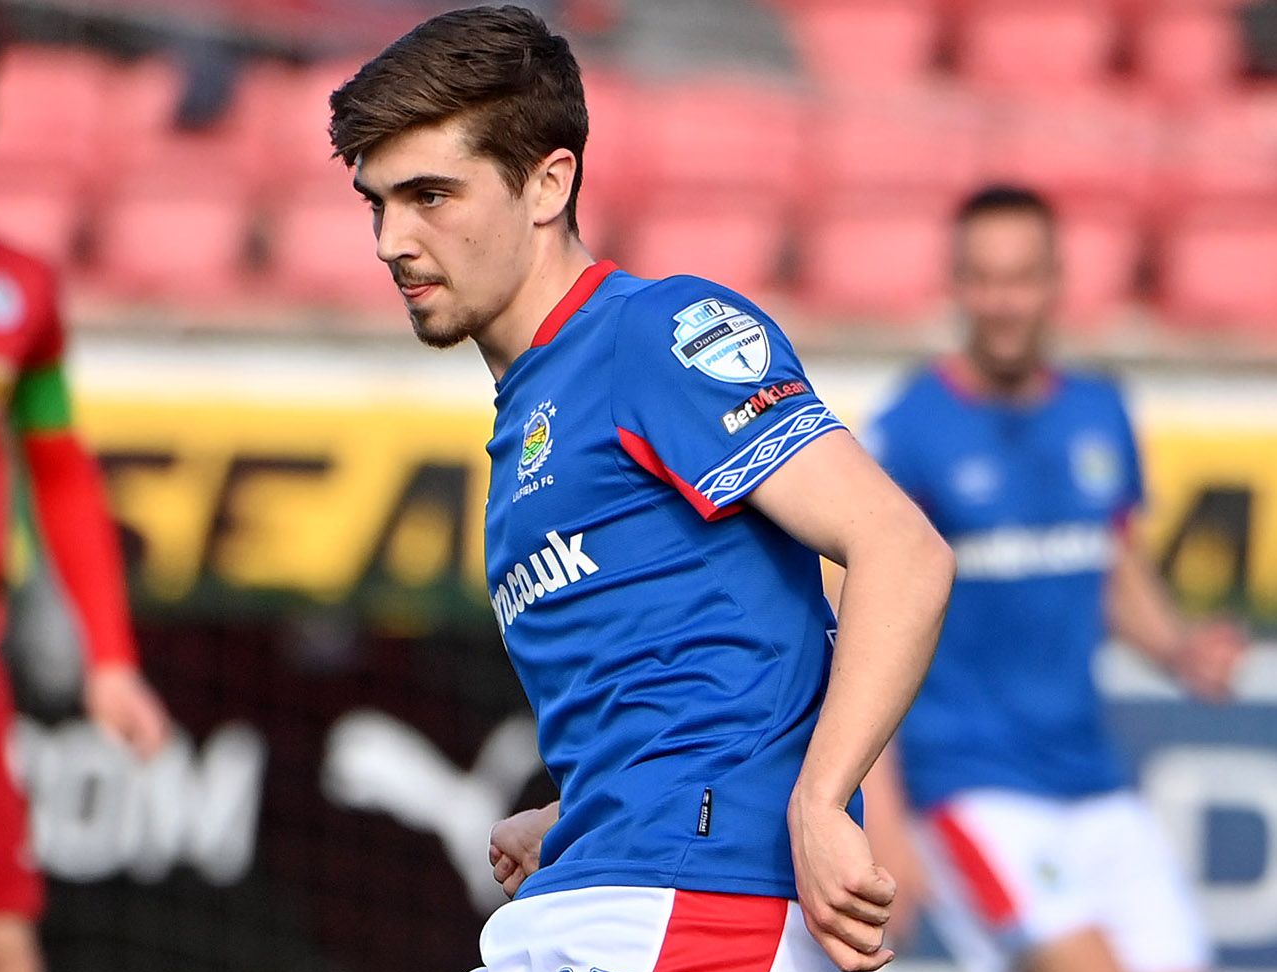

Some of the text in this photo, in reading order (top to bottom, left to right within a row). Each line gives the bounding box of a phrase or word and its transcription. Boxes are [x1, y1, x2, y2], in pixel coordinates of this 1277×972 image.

[693, 326, 732, 350] Danske
[705, 333, 761, 366] PREMIERSHIP
[722, 381, 809, 435] BetMcLean
[541, 474, 554, 488] FC
